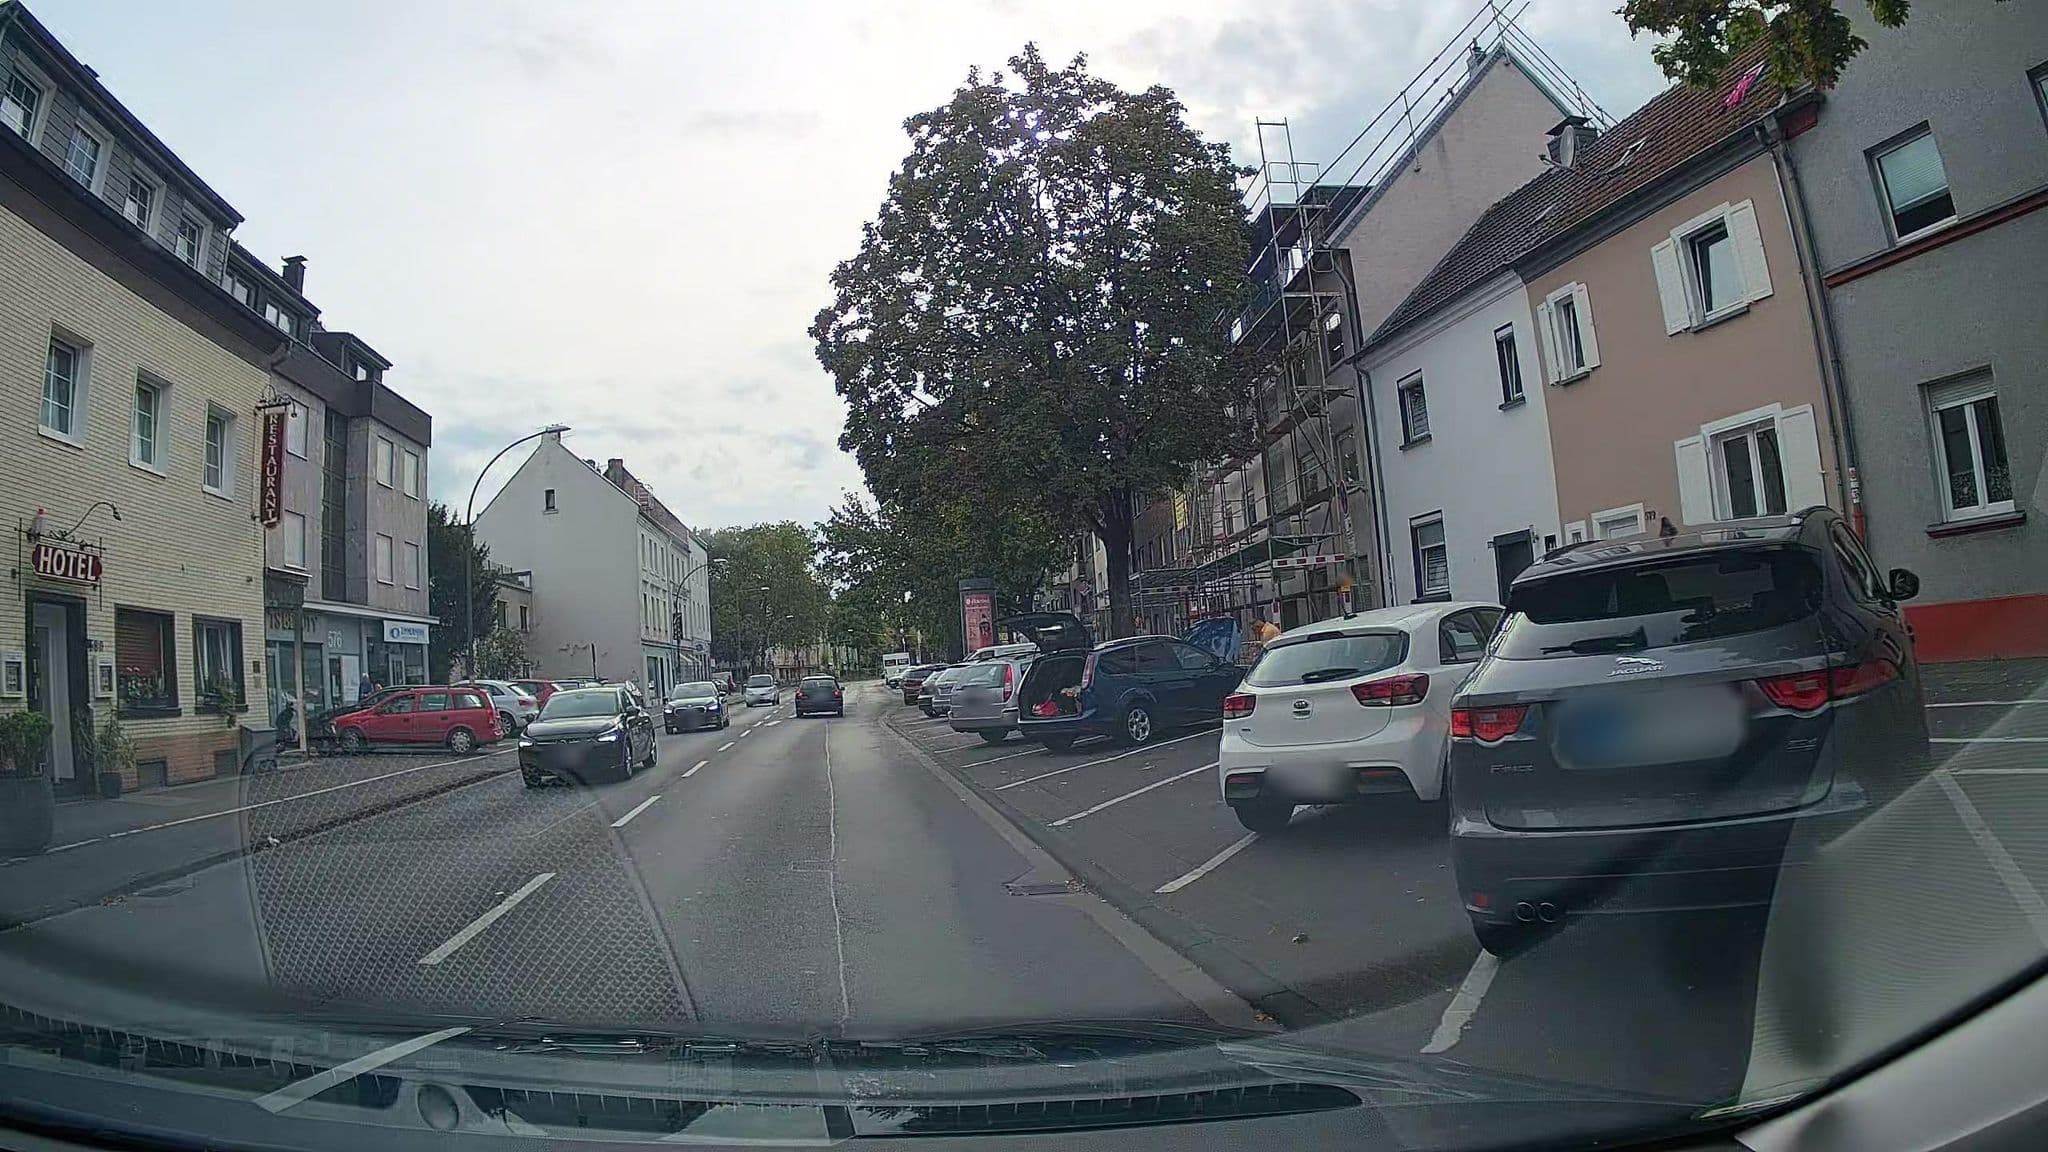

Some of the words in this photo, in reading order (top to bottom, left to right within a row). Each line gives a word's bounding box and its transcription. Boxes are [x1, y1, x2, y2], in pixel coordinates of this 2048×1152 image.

[265, 414, 278, 518] RESTAURANT
[38, 547, 96, 580] HOTEL
[328, 631, 343, 648] 576
[1606, 665, 1664, 677] JAGUAR
